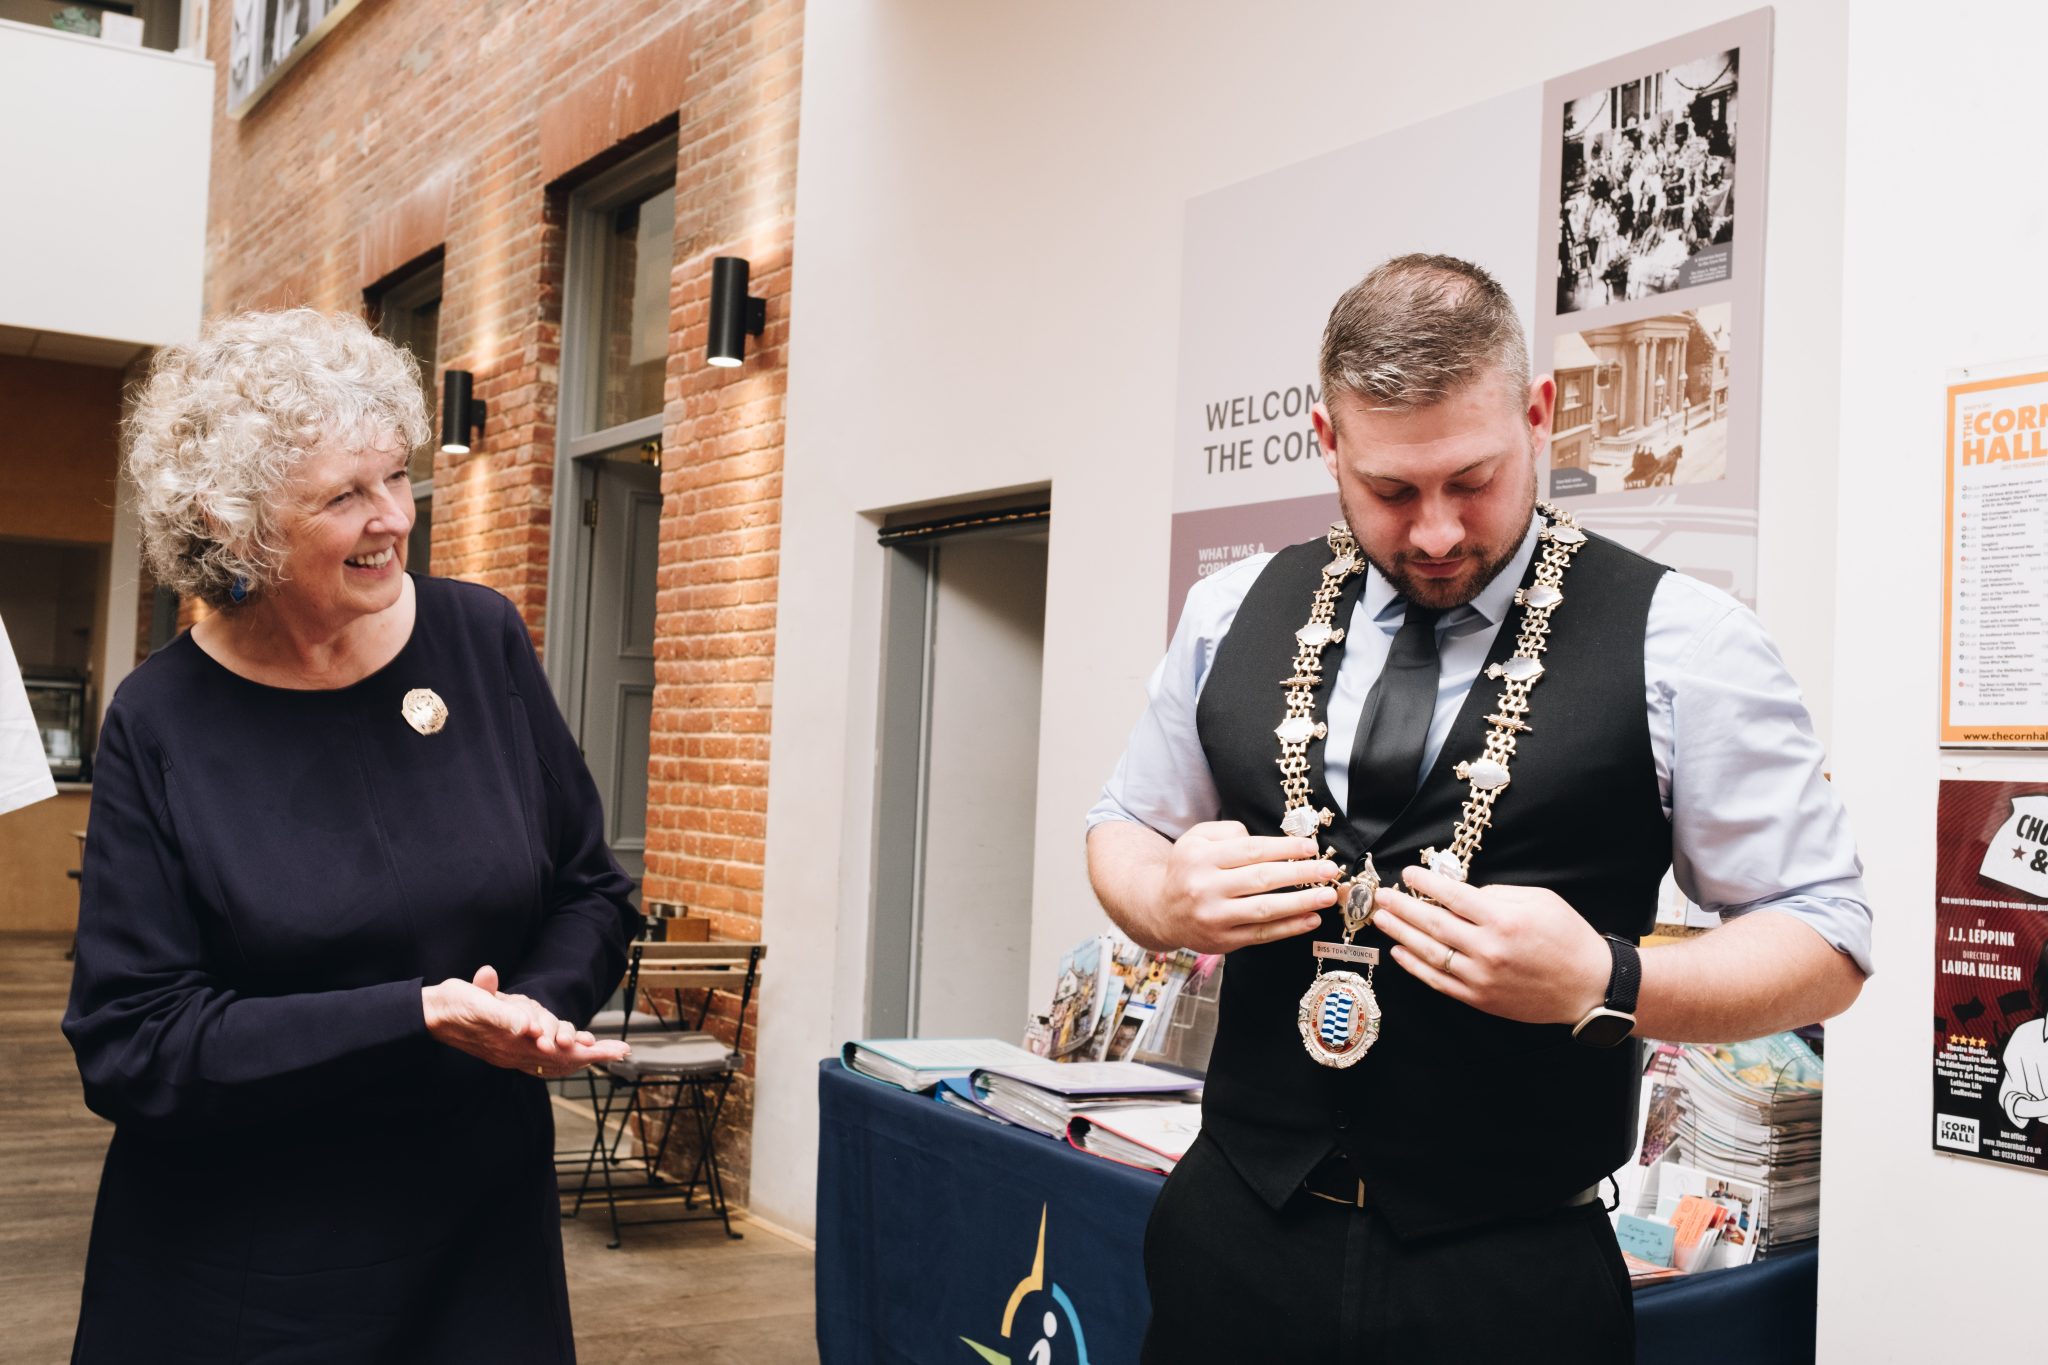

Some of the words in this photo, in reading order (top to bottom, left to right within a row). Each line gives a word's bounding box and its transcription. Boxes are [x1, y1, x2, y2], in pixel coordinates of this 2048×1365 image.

[1204, 439, 1253, 474] THE
[1962, 431, 2048, 466] HALL
[1199, 546, 1229, 560] WHAT
[1231, 544, 1255, 558] WAS
[1258, 542, 1264, 553] A
[2030, 849, 2048, 874] &
[1970, 898, 1992, 907] changed
[1978, 918, 1985, 927] BY
[1948, 927, 1966, 942] J.J.
[1969, 928, 2015, 947] LEPPINK
[1963, 950, 1990, 960] DIRECTED
[1992, 953, 1999, 962] BY
[1942, 959, 1976, 976] LAURA
[1978, 963, 2021, 982] KILLEEN
[1947, 1043, 1968, 1053] Theatre
[1968, 1046, 1988, 1057] Weekly
[1940, 1052, 1958, 1060] British
[1959, 1054, 1979, 1064] Theatre
[1981, 1056, 1997, 1065] Guide
[1936, 1059, 1945, 1067] The
[1946, 1060, 1973, 1072] Edinburgh
[1974, 1064, 1999, 1075] Reporter
[1938, 1068, 1958, 1078] Theatre
[1964, 1072, 1973, 1080] Art
[1974, 1074, 1996, 1084] Reviews
[1950, 1079, 1970, 1089] Lothian
[1972, 1081, 1982, 1090] Life
[1945, 1122, 1974, 1134] CORN
[1942, 1130, 1971, 1143] HALL
[1983, 1138, 2041, 1155] www.thecornhall.co.uk
